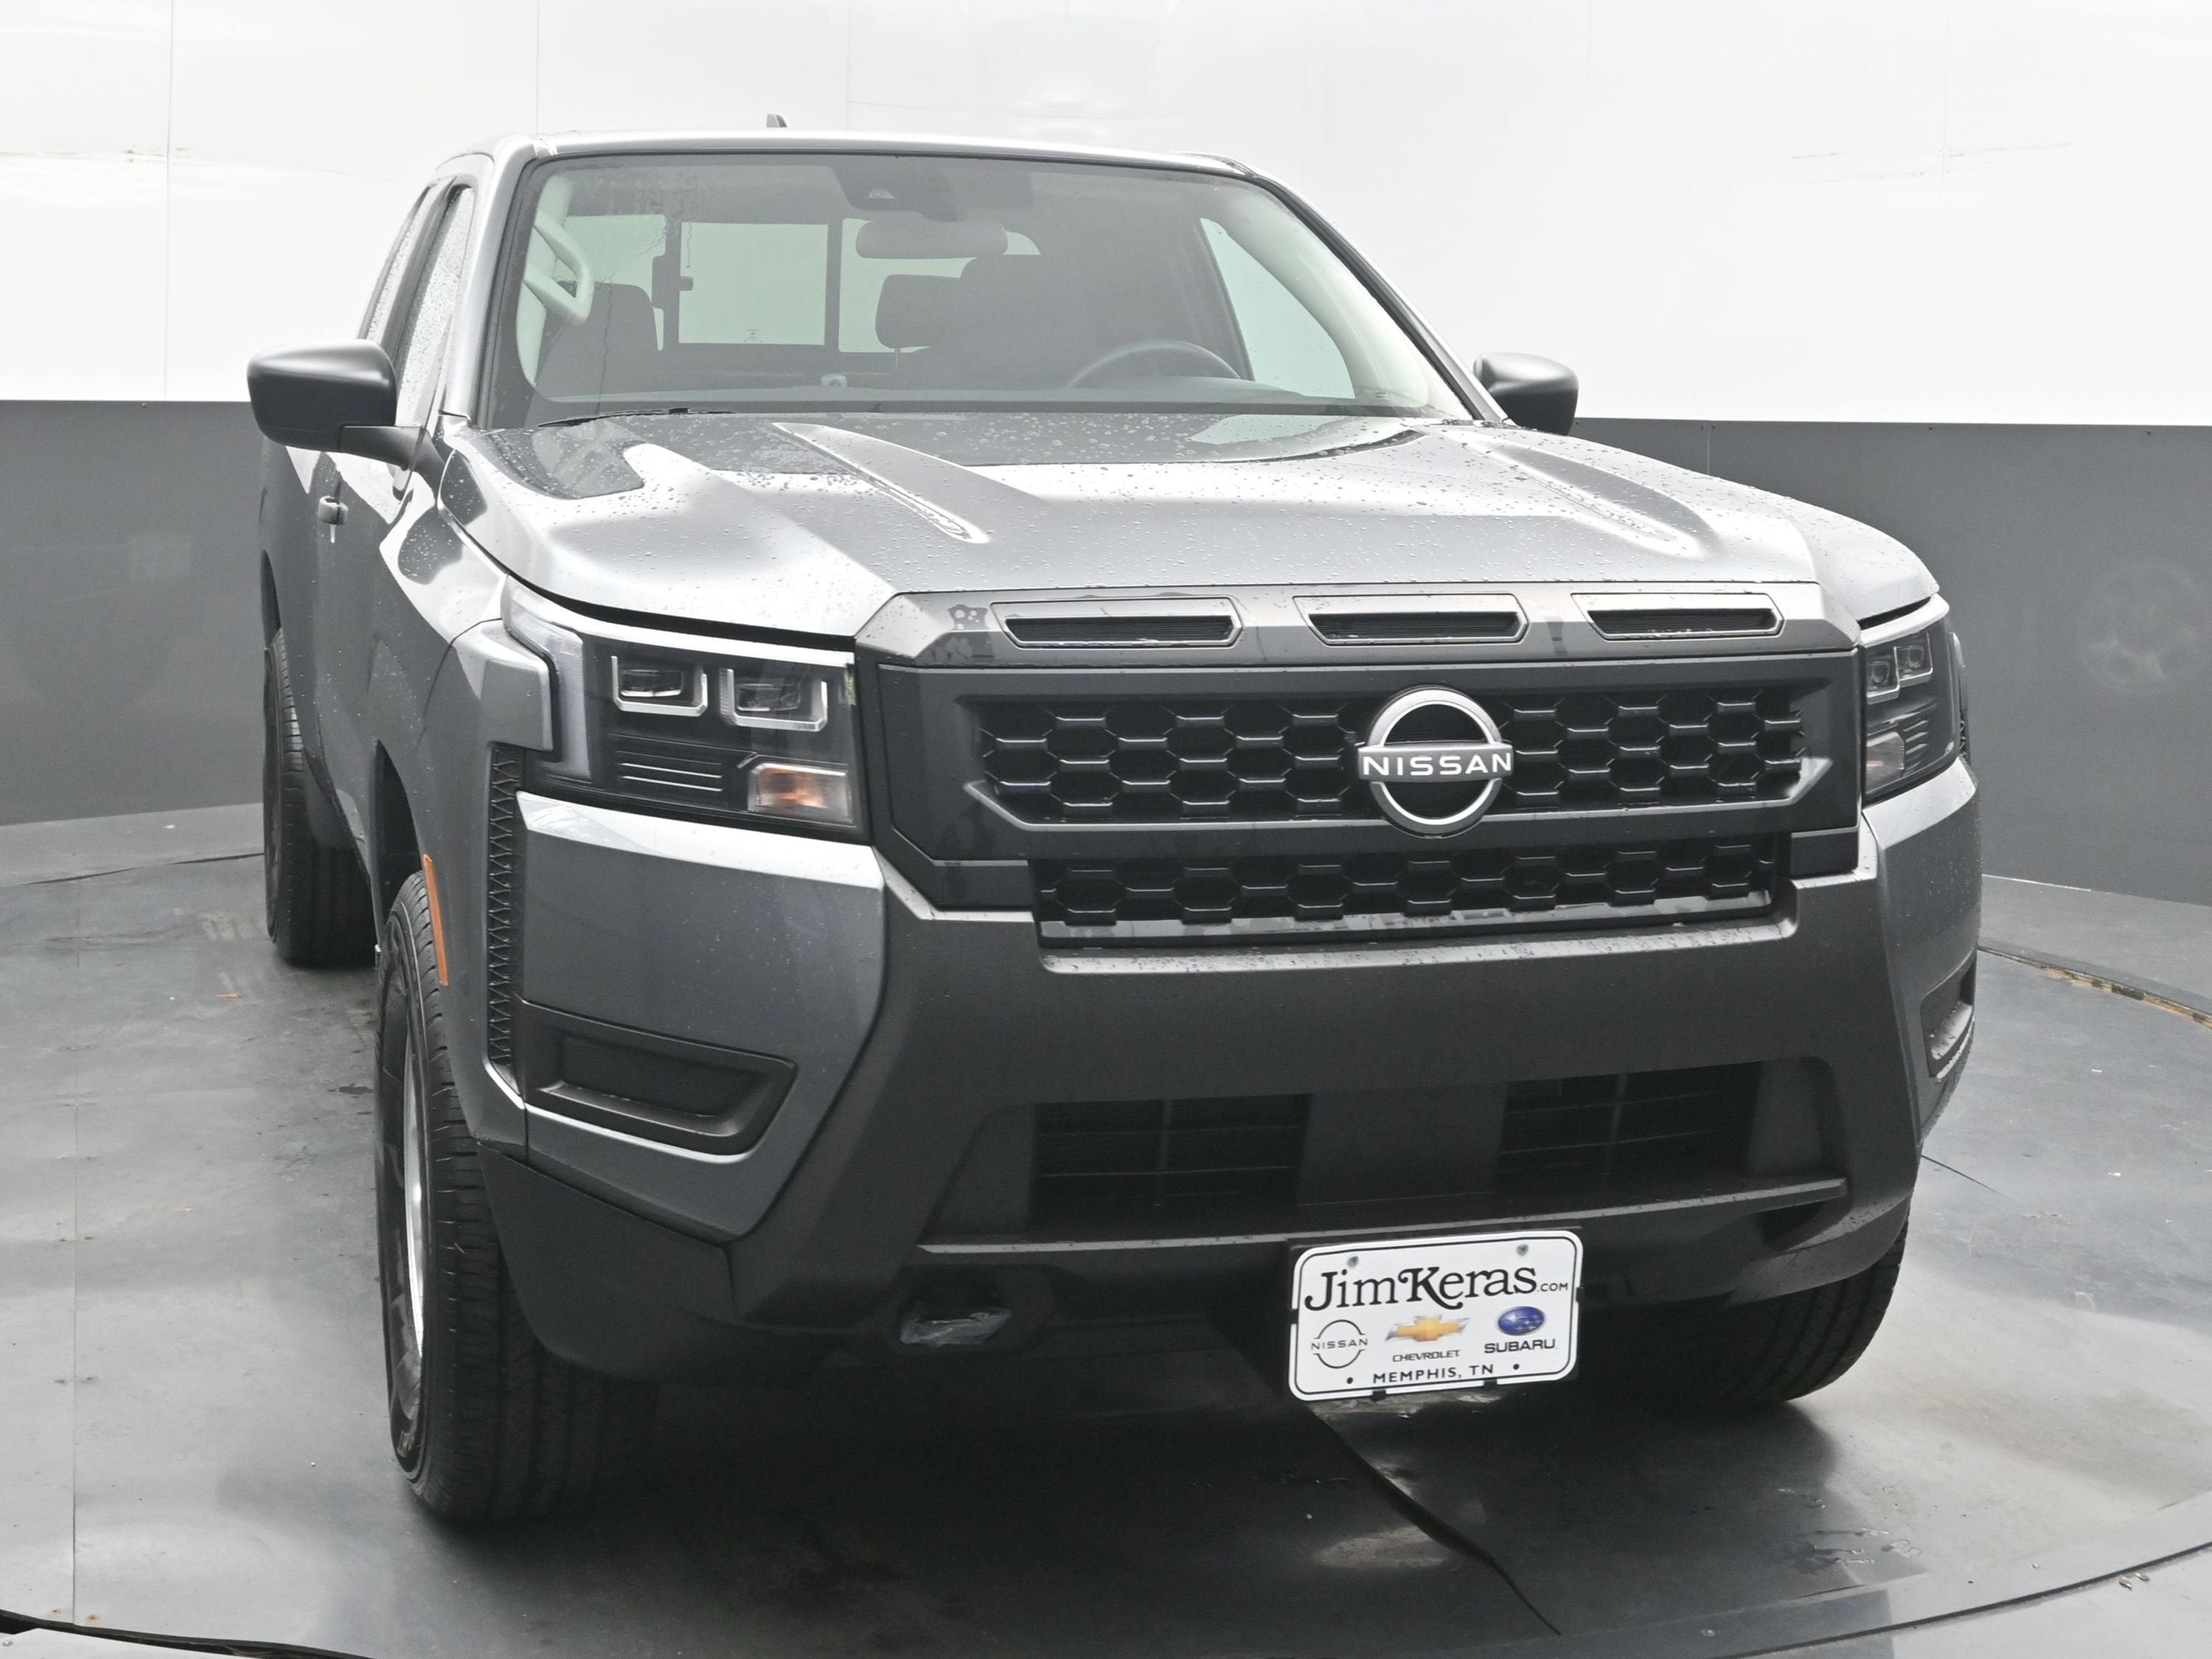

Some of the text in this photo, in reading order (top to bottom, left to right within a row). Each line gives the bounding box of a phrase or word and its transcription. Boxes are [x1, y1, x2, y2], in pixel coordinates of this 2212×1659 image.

[1363, 752, 1512, 776] NISSAN
[1311, 1338, 1368, 1350] NISSAN
[1484, 1338, 1556, 1354] SUBARU
[1392, 1349, 1461, 1363] CHEVROLET
[1373, 1364, 1494, 1384] MEMPHIS, TN
